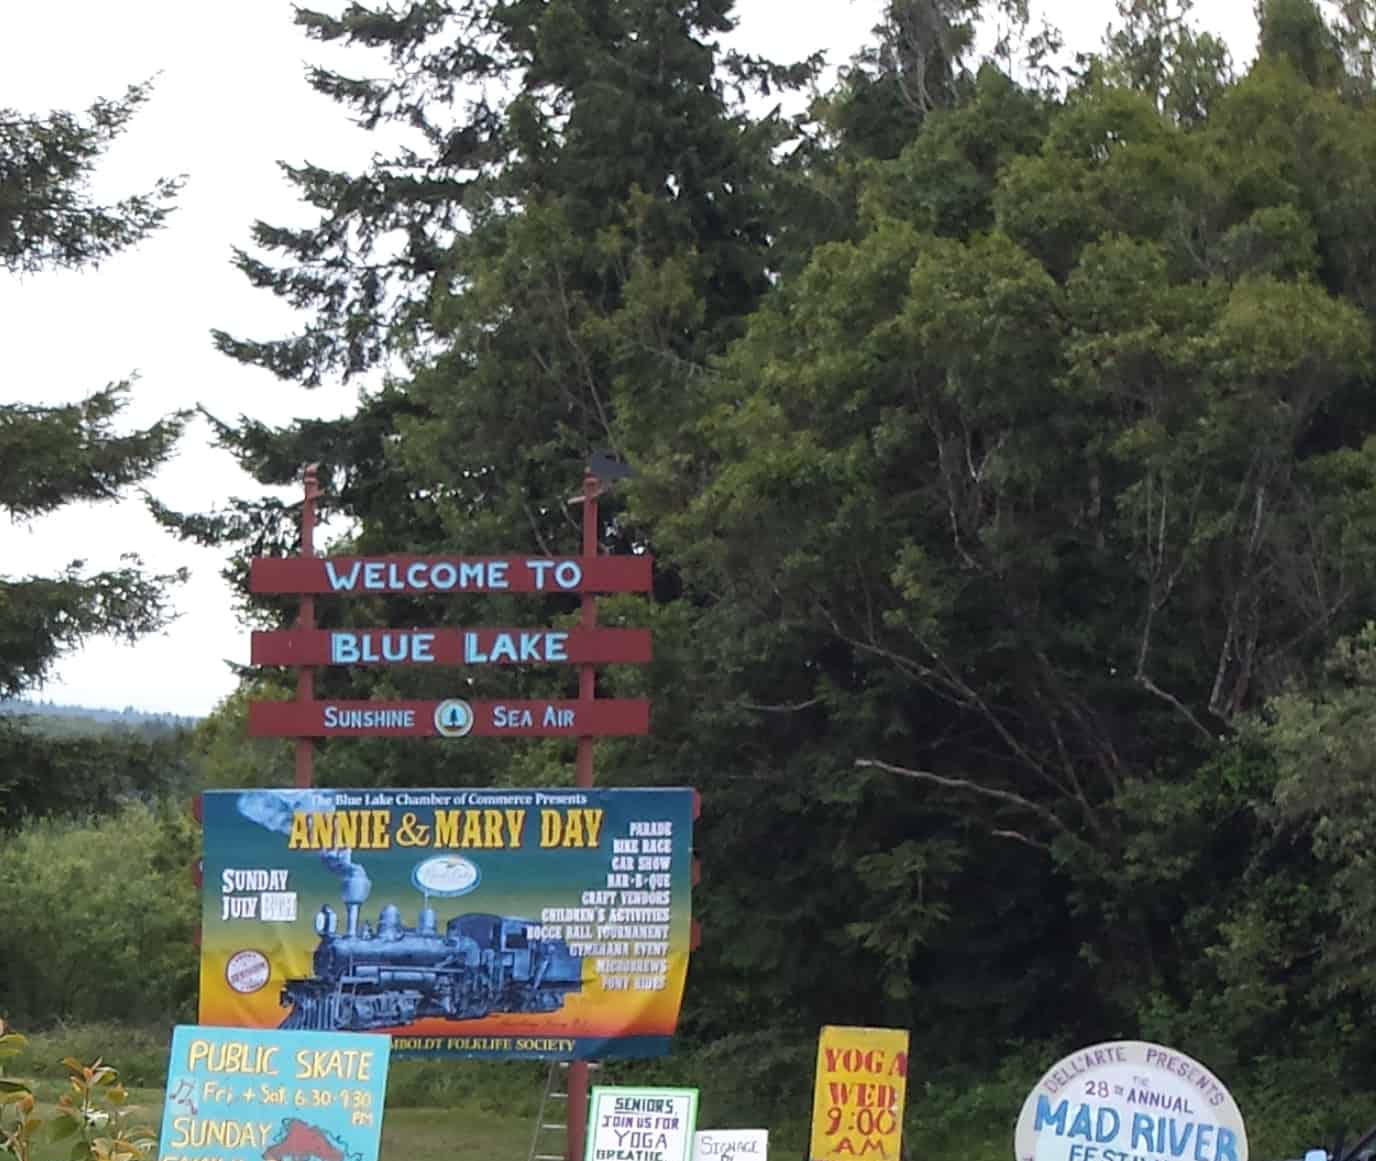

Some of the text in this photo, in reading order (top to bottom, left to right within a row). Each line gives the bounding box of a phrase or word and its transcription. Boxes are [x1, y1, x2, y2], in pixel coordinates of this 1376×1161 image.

[325, 560, 582, 590] WELCOME TO
[331, 632, 569, 664] BLUE LAKE
[323, 706, 575, 728] SUNSHINE SEA AIR
[336, 793, 362, 806] Blue
[365, 793, 393, 806] Lake
[395, 792, 451, 806] Chamber
[453, 792, 467, 805] of
[468, 793, 532, 805] Commerce
[535, 793, 588, 805] Presents
[288, 809, 603, 848] ANNIE & MARY DAY
[629, 821, 673, 836] PARADE
[613, 839, 672, 854] BIKE RACE
[611, 856, 672, 871] CAR SHOW
[222, 868, 288, 893] SUNDAY
[222, 896, 258, 920] JULY
[581, 891, 670, 905] CRAFT VENDORS
[609, 908, 670, 922] ACTIVITIES
[566, 925, 592, 939] BALL
[597, 925, 670, 939] TOURNAMENT
[391, 1038, 576, 1052] MBOLDT FOLKLIFE SOCIETY
[188, 1040, 375, 1081] PUBLIC SKATE
[824, 1046, 908, 1077] YOGA
[1146, 1048, 1224, 1106] PRESENTS
[829, 1082, 896, 1108] WED
[1127, 1087, 1194, 1114] ANNUAL
[601, 1115, 679, 1130] JOIN US FOR
[824, 1107, 896, 1136] 9:00
[1034, 1093, 1121, 1144] MAD
[171, 1117, 272, 1148] SUNDAY
[614, 1130, 668, 1150] YOGA
[831, 1137, 888, 1160] AM
